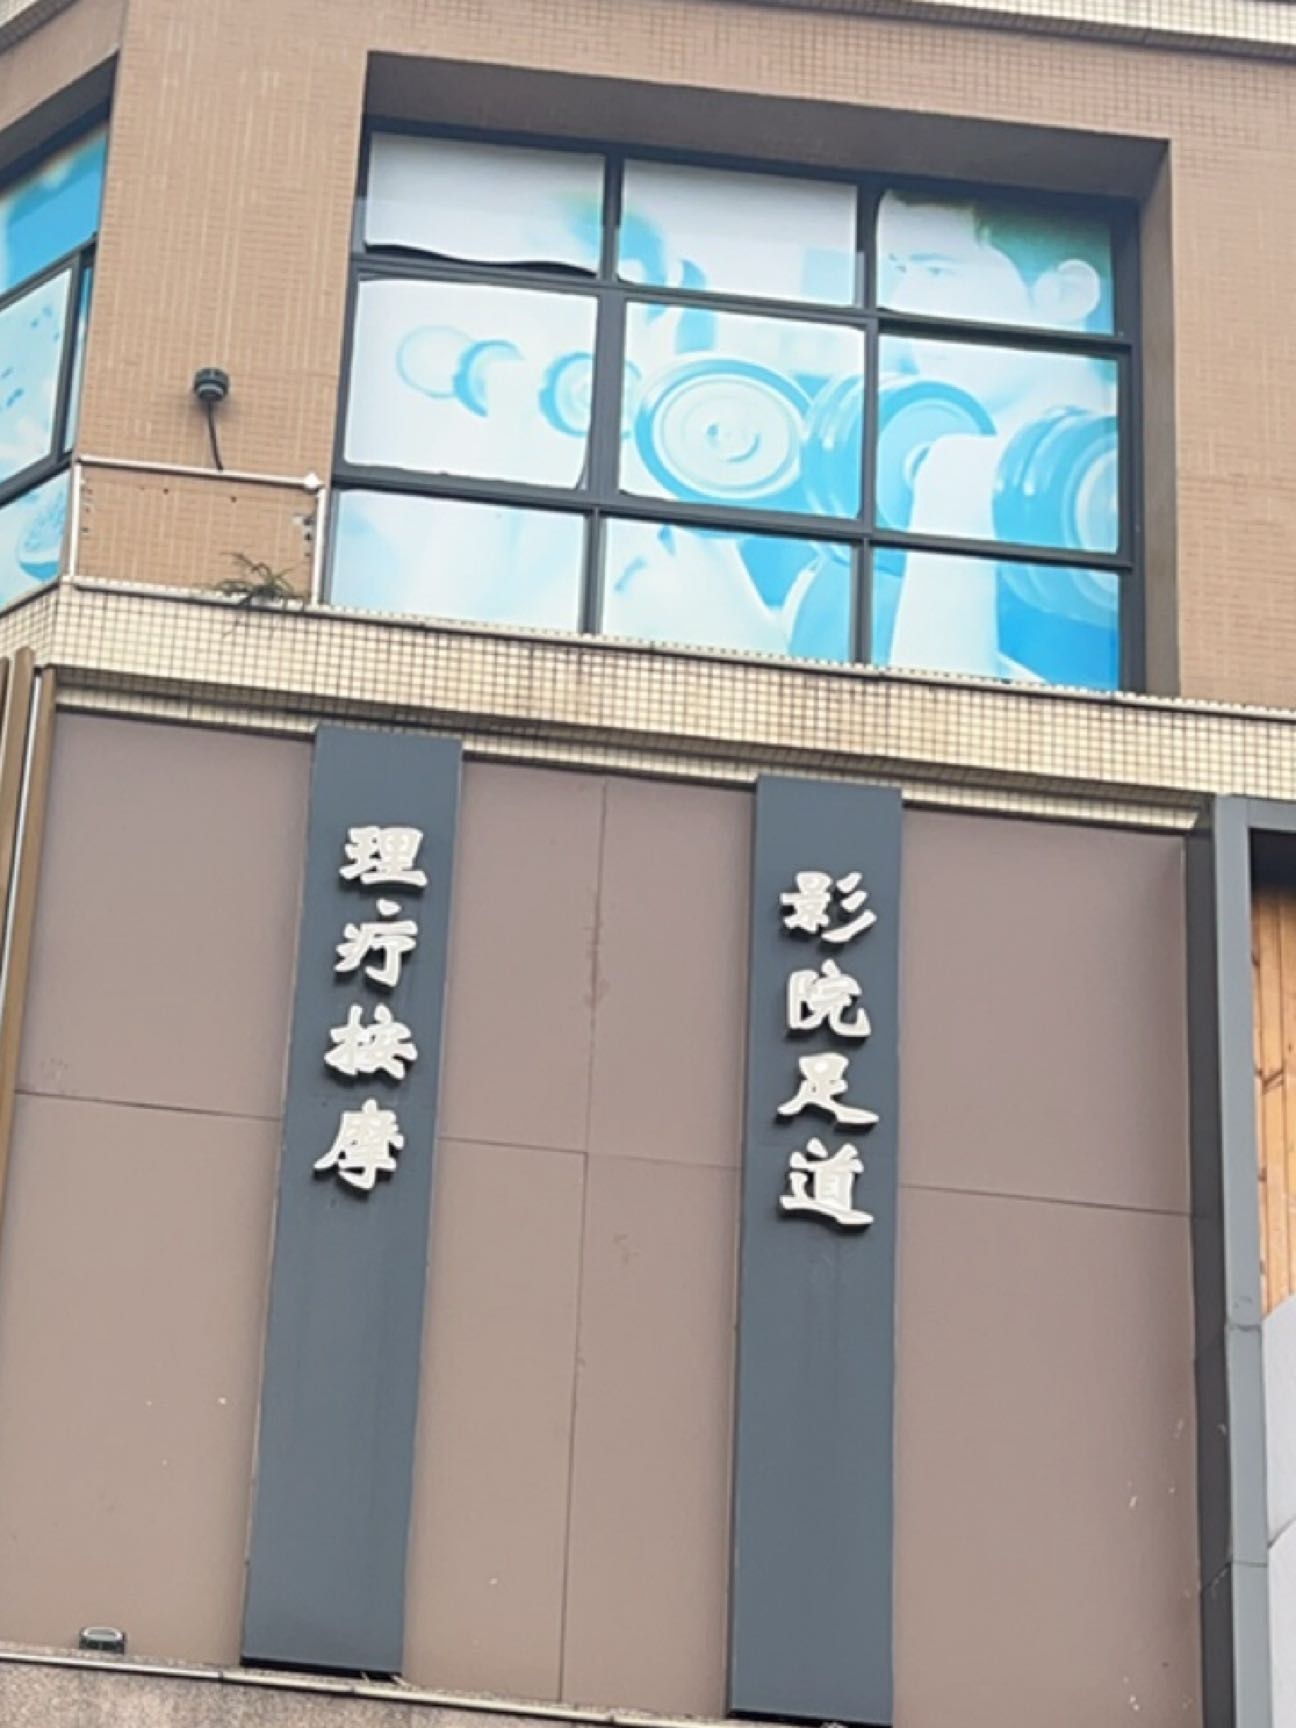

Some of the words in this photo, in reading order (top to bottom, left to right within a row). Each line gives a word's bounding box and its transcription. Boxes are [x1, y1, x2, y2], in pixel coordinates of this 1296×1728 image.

[313, 825, 428, 1191] 理疗按摩
[777, 870, 880, 1227] 影院足道
